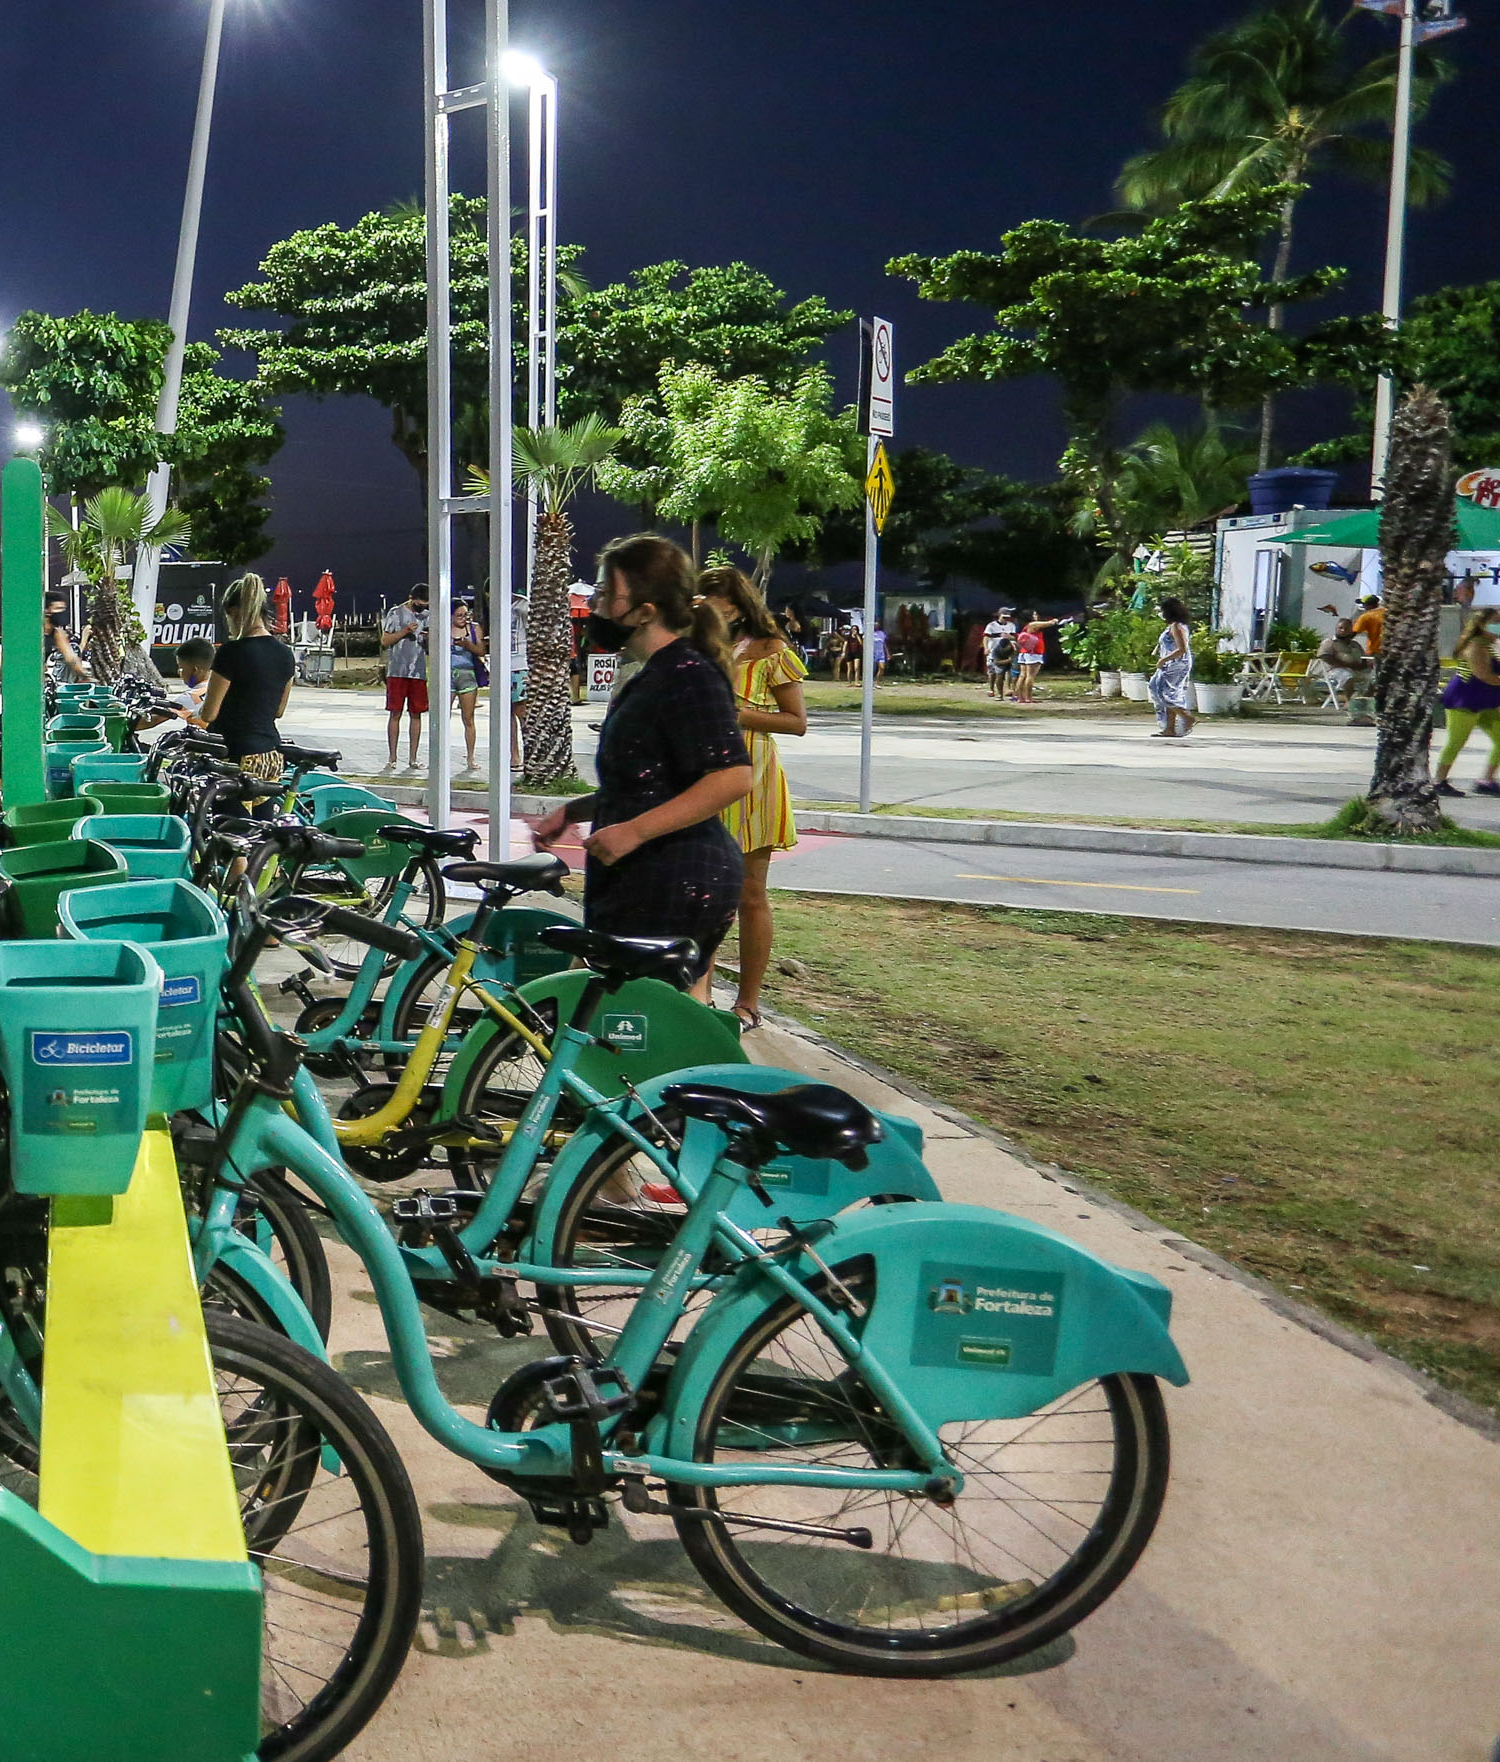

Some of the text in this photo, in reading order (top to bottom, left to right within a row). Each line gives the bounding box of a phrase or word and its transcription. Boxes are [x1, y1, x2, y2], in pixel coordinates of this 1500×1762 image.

[66, 1042, 125, 1054] Bicicletar
[976, 1287, 1054, 1302] Prefeitura de
[974, 1298, 1053, 1317] Fortaleza
